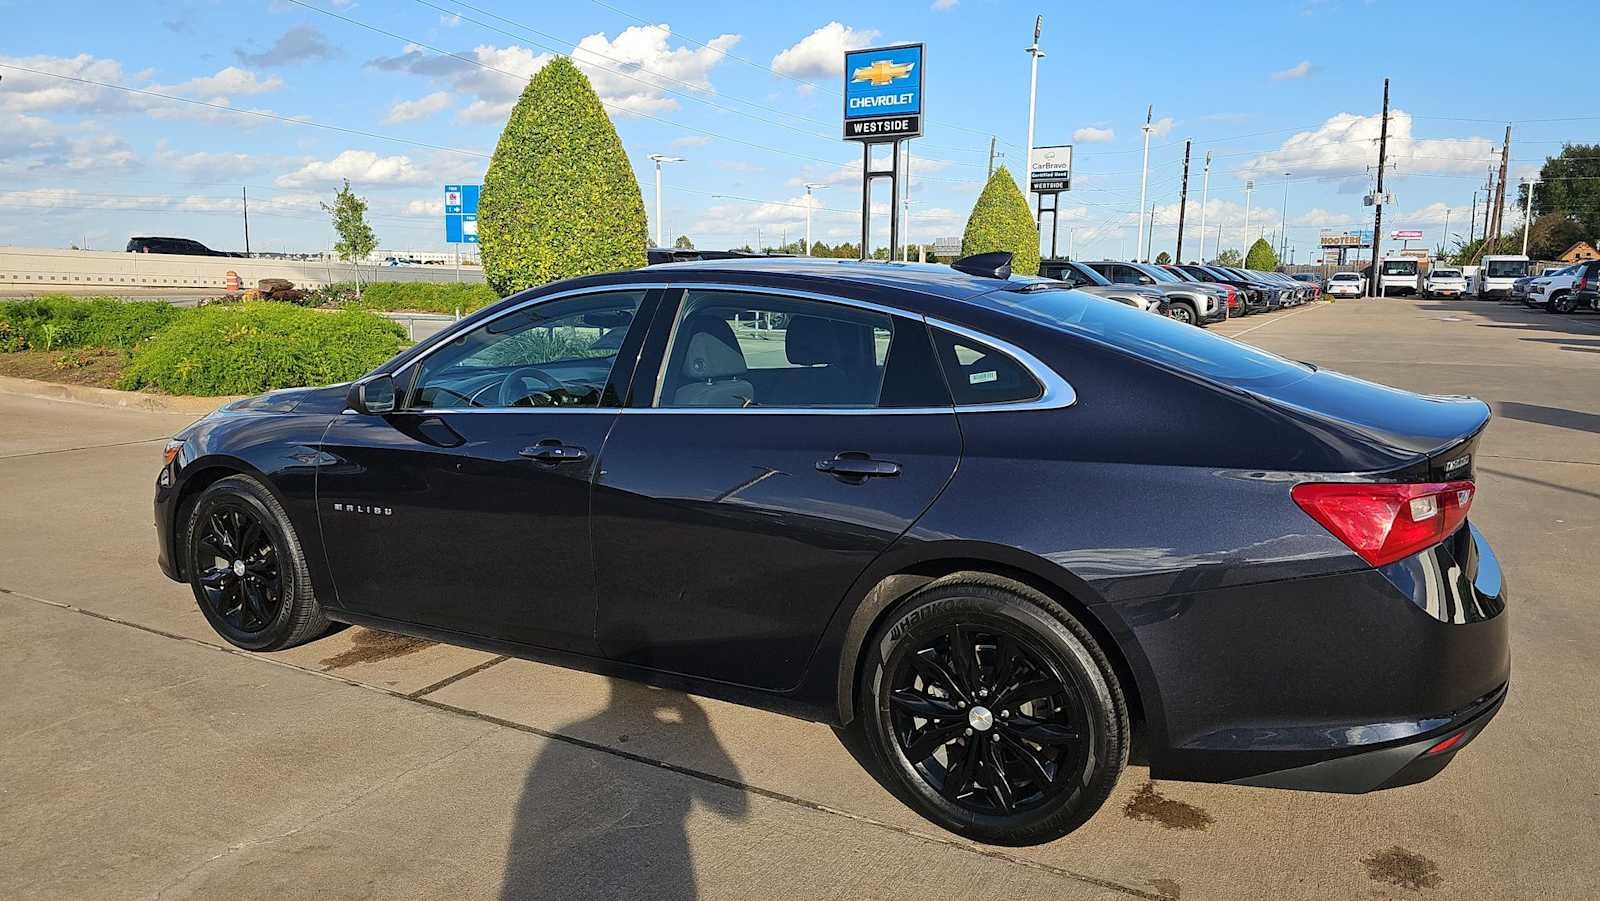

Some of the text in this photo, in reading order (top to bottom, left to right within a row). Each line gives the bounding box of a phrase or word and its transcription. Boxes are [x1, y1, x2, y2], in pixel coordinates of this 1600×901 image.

[849, 93, 915, 109] CHEVROLET
[853, 119, 909, 133] WESTSIDE
[1032, 162, 1067, 170] CarBravo
[334, 503, 392, 515] MALIBU
